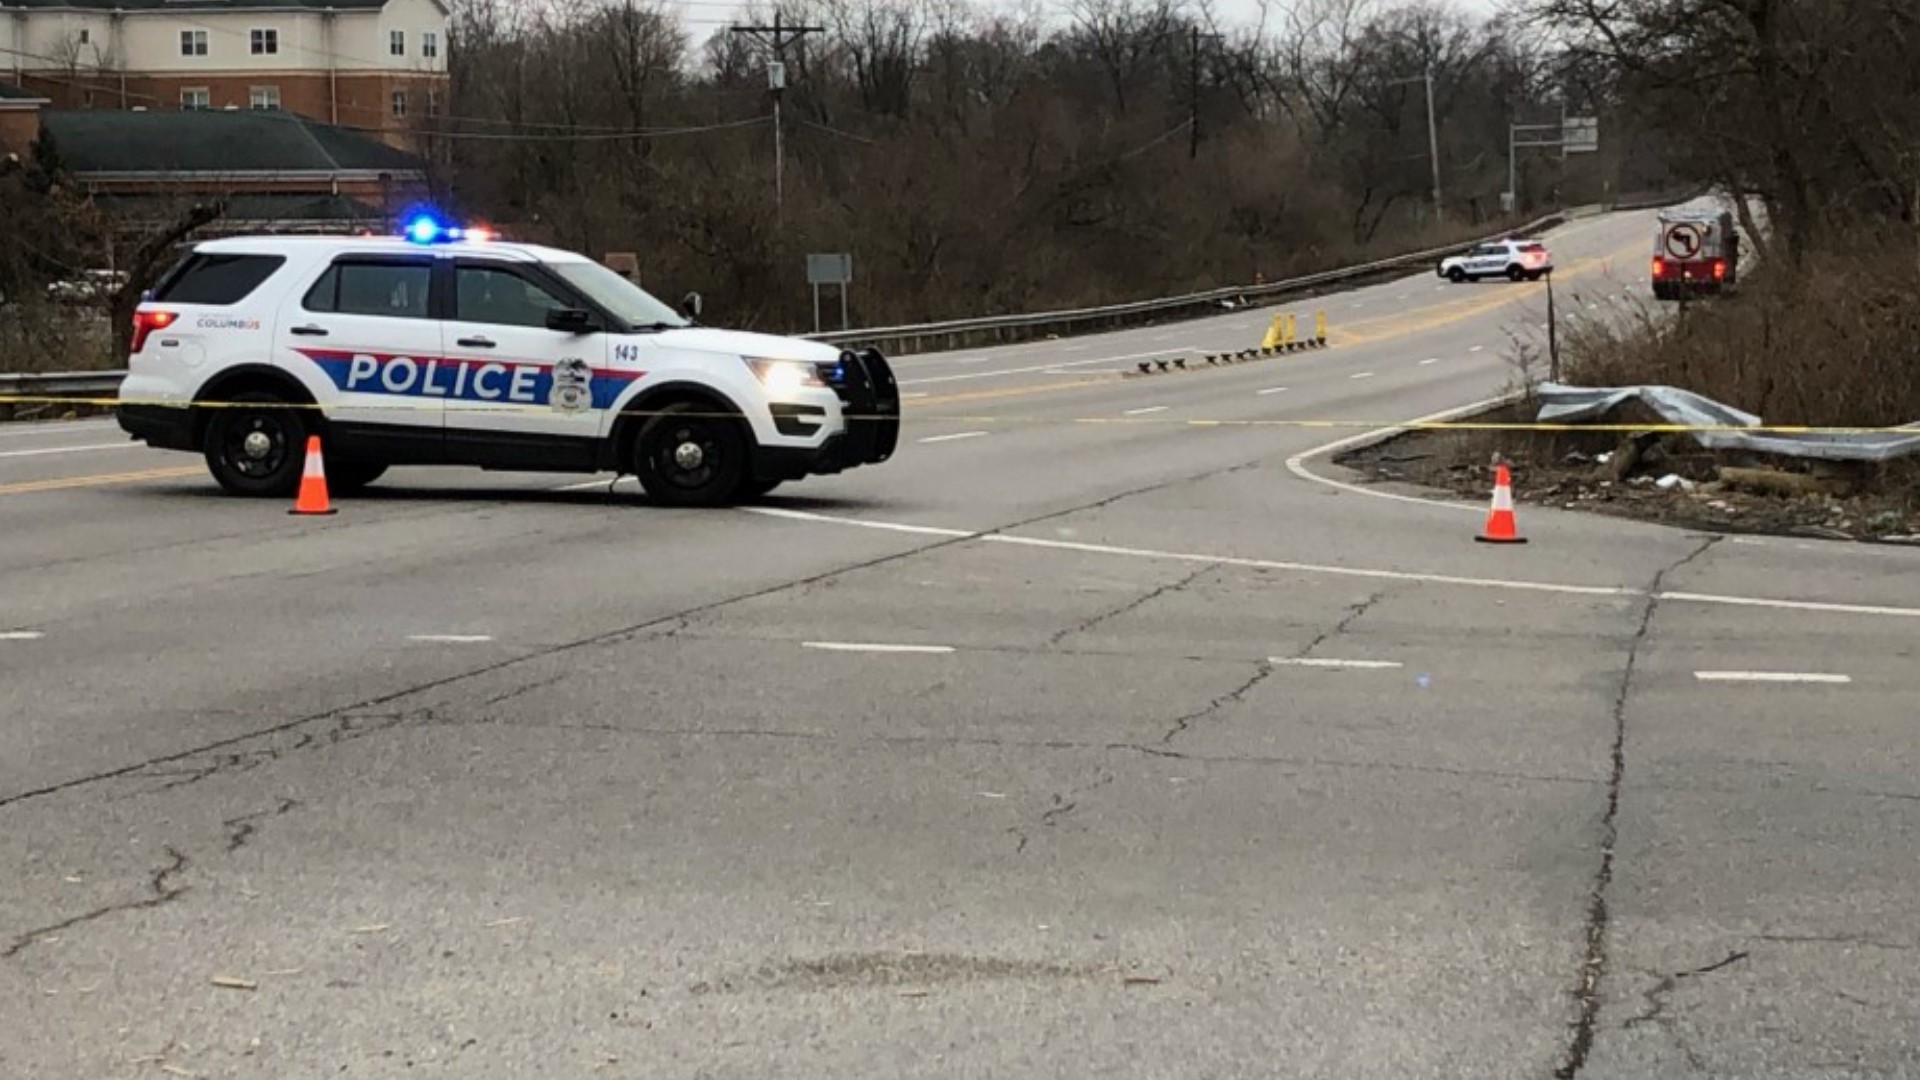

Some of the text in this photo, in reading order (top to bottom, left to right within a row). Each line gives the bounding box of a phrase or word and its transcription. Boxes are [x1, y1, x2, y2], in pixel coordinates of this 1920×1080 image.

[196, 318, 260, 330] COLUMBUS
[615, 343, 638, 361] 143
[346, 353, 542, 402] POLICE
